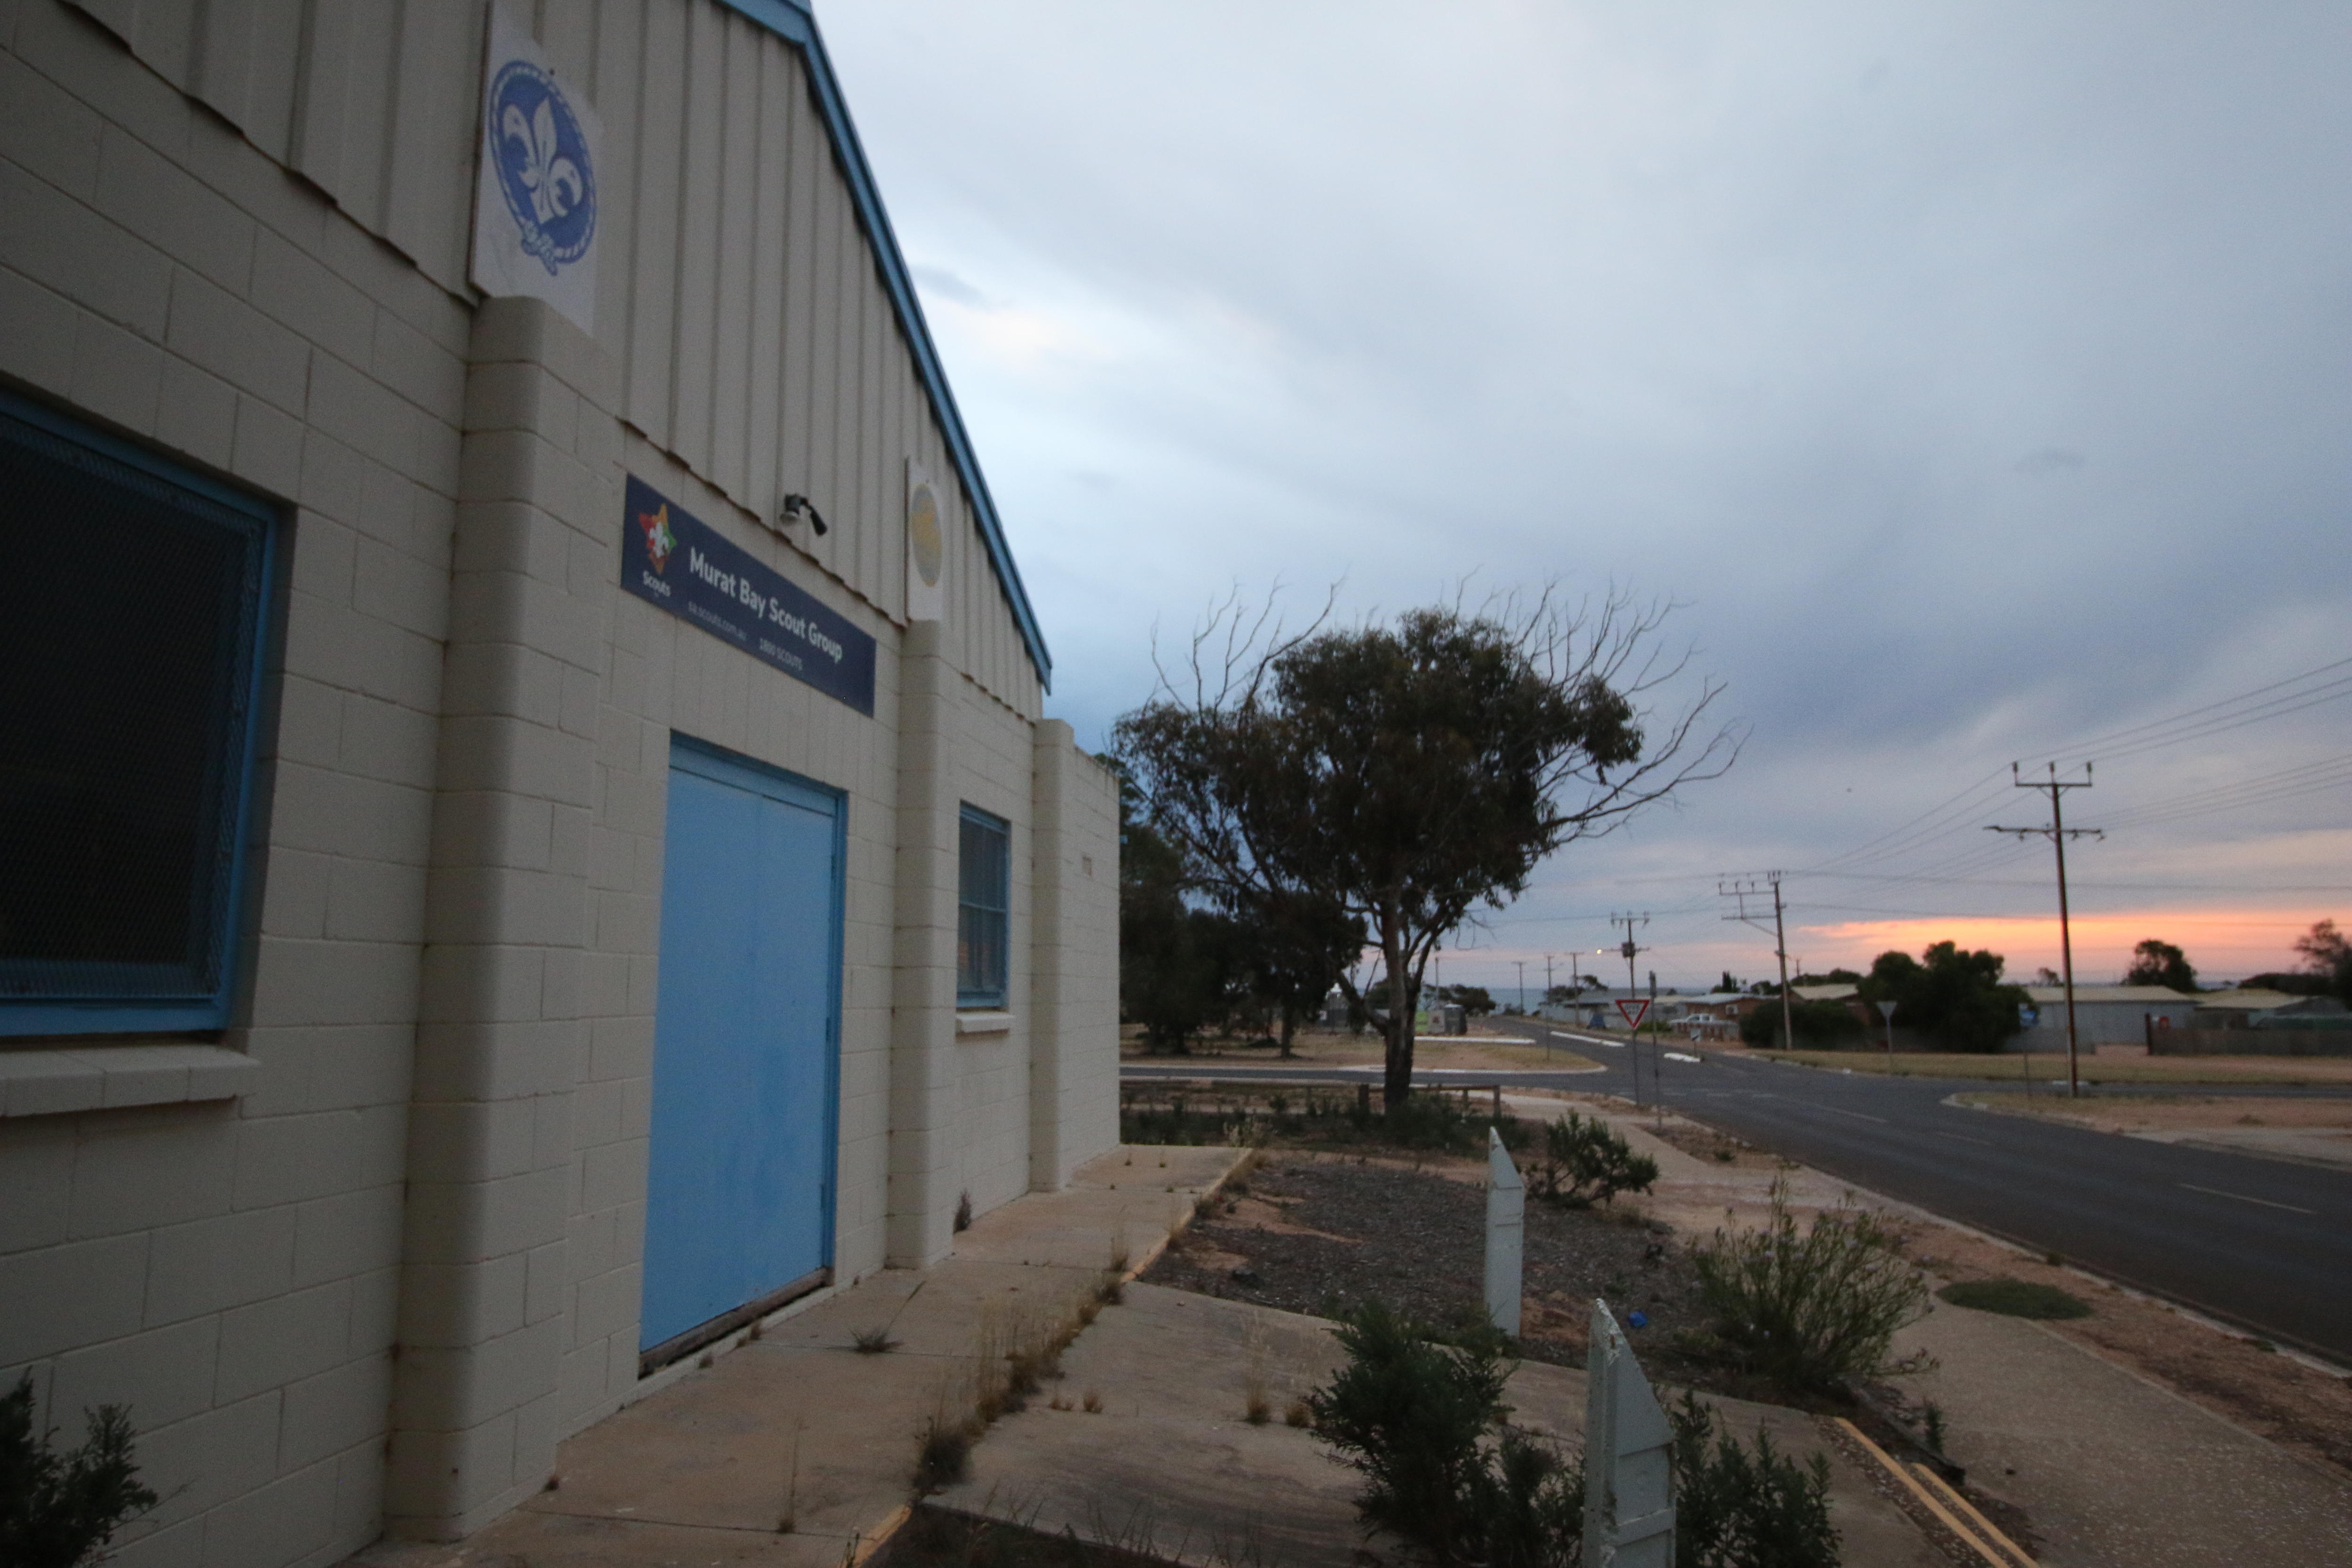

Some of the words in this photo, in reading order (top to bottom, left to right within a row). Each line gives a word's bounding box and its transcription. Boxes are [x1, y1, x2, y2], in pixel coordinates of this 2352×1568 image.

[643, 570, 671, 597] Scouts
[690, 546, 736, 598] Murat
[739, 577, 766, 619] Bay
[769, 597, 805, 639] Scout
[808, 622, 843, 664] Group
